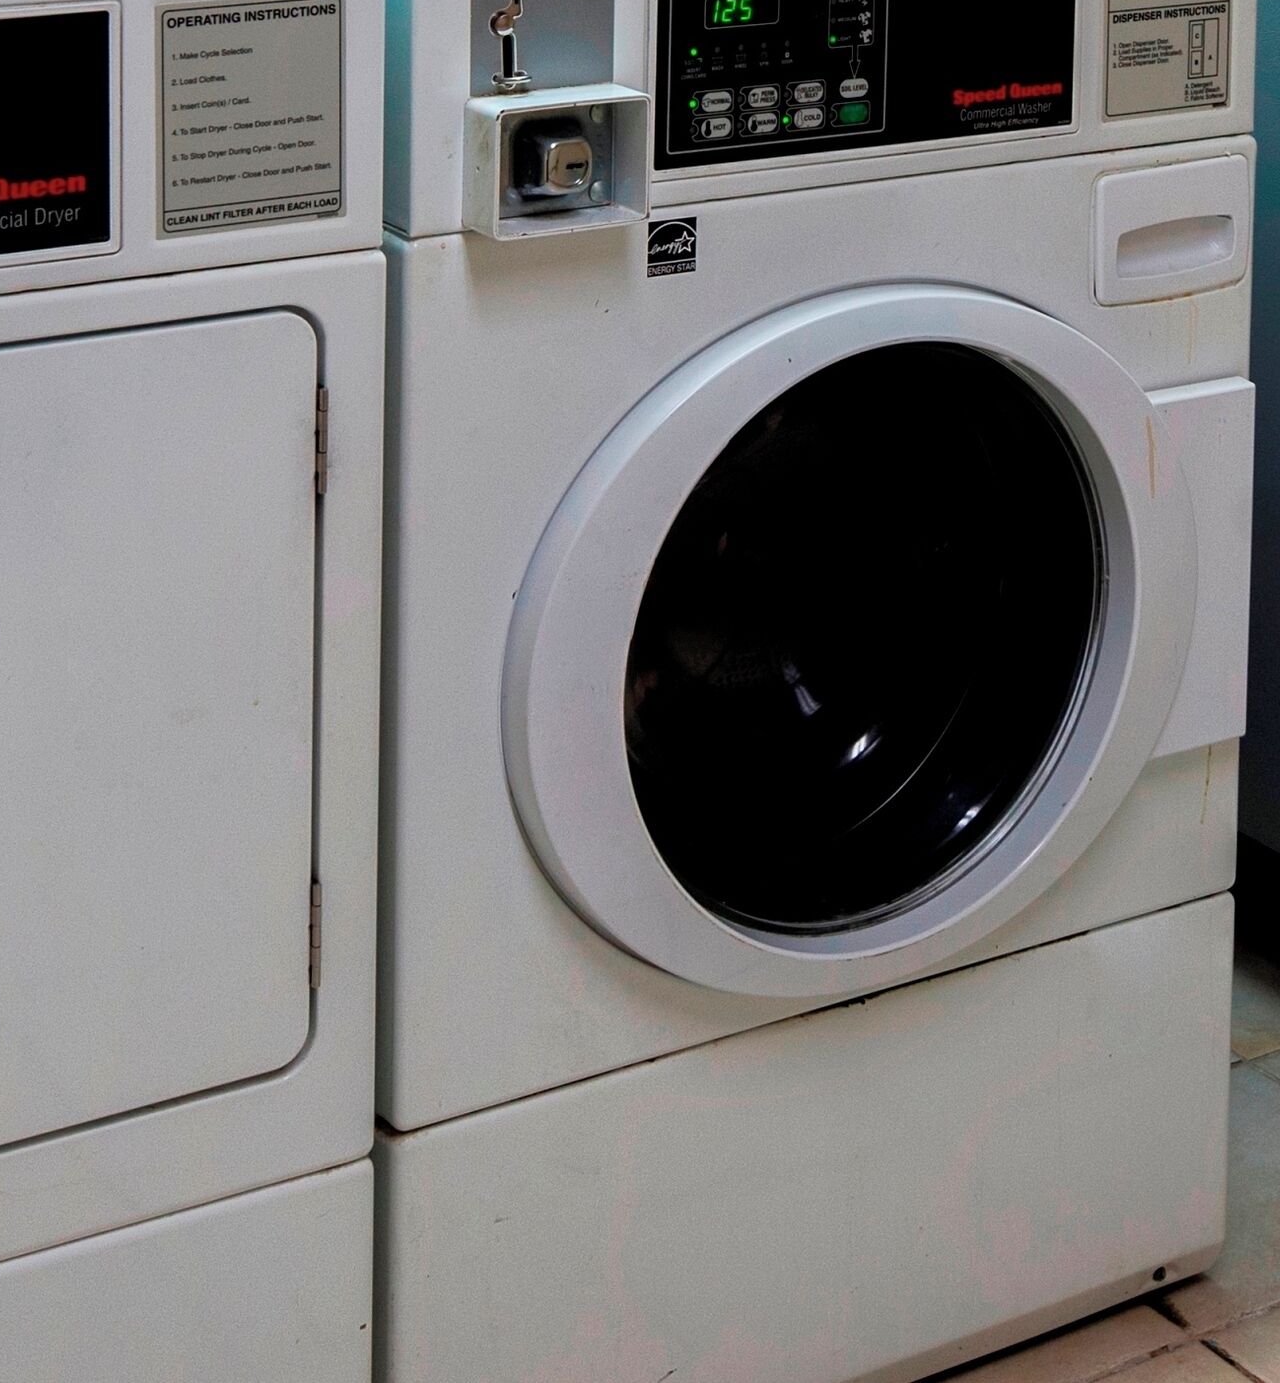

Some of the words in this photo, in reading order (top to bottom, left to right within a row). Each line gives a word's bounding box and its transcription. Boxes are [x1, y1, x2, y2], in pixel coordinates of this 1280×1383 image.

[167, 12, 240, 29] OPERATING
[244, 4, 336, 22] INSTRUCTIONS
[1113, 10, 1162, 23] DISPENSER
[1164, 4, 1226, 18] INSTRUCTIONS
[179, 51, 199, 59] Make
[200, 49, 220, 58] Cycle
[180, 76, 197, 85] Load
[953, 85, 1006, 107] Speed
[1010, 82, 1062, 99] Queen
[180, 102, 200, 110] Insert
[960, 103, 1016, 121] Commercial
[1017, 101, 1052, 115] Washer
[180, 127, 189, 135] To
[190, 126, 207, 134] Start
[208, 123, 228, 133] Dryer
[233, 121, 253, 129] Close
[254, 119, 272, 127] Door
[273, 117, 286, 125] and
[287, 115, 305, 124] Push
[757, 118, 776, 126] WARM
[973, 121, 989, 130] Ultra
[991, 119, 1006, 129] High
[1007, 117, 1039, 127] Efficiency
[190, 151, 206, 160] Stop
[207, 149, 227, 158] Dryer
[228, 146, 252, 155] During
[252, 144, 272, 154] Cycle
[277, 141, 296, 151] Open
[190, 175, 216, 184] Restart
[217, 173, 237, 182] Dryer
[242, 170, 262, 179] Close
[263, 168, 280, 176] Door
[281, 166, 294, 174] and
[295, 164, 313, 173] Push
[35, 206, 81, 227] Dryer
[167, 215, 198, 225] CLEAN
[200, 212, 221, 222] LINT
[223, 208, 253, 219] FILTER
[255, 205, 285, 215] AFTER
[287, 201, 312, 212] EACH
[314, 198, 338, 208] LOAD
[648, 264, 676, 276] ENERGY
[676, 262, 696, 272] STAR
